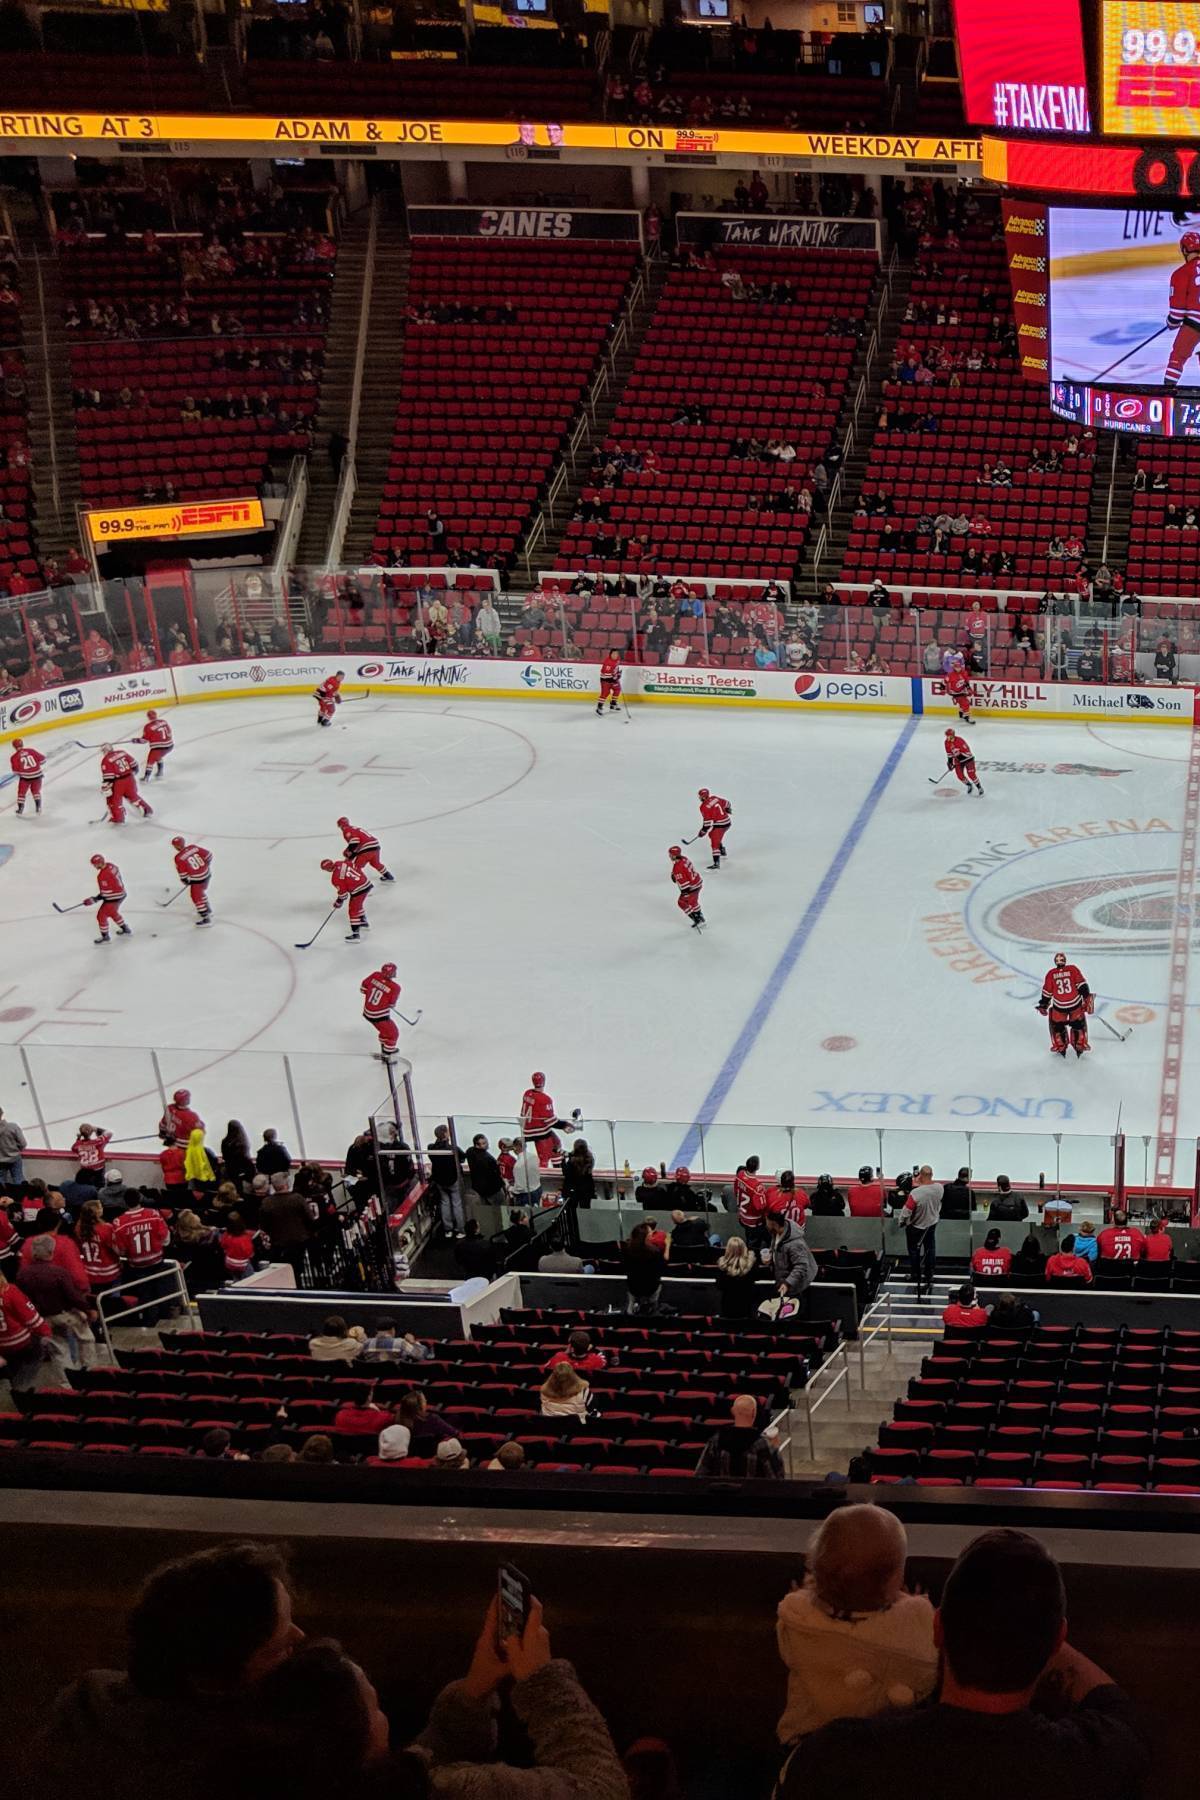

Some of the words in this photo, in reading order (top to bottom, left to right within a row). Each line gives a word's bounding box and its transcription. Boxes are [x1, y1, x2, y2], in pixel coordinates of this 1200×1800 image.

[1122, 28, 1195, 65] 99.9
[0, 116, 82, 136] RTING
[102, 118, 129, 136] AT
[139, 118, 154, 136] 3
[275, 121, 350, 139] ADAM
[366, 123, 383, 140] &
[397, 123, 442, 142] JOE
[628, 129, 663, 148] ON
[808, 135, 920, 157] WEEKDAY
[479, 210, 572, 238] CANES
[722, 221, 761, 242] TAKE
[769, 221, 842, 245] WARNING
[1124, 210, 1164, 240] LIVE
[1150, 400, 1162, 422] 0
[1104, 419, 1151, 433] HURRICANES
[181, 503, 250, 526] ESPN
[100, 518, 134, 533] 99.9
[198, 671, 248, 682] VECTOR
[385, 661, 415, 678] TAKE
[417, 661, 471, 686] WARNING
[544, 667, 573, 678] DUKE
[657, 672, 703, 685] Harris
[707, 674, 754, 687] Teeter
[545, 677, 589, 690] ENERGY
[826, 681, 884, 700] pepsi
[931, 681, 994, 698] BLY
[1002, 684, 1047, 700] HILL
[44, 699, 57, 712] ON
[952, 697, 1028, 709] VNEYARDS
[1073, 693, 1124, 708] Michael
[1157, 698, 1181, 711] Son
[19, 755, 37, 769] 20
[947, 842, 1026, 877] PNC
[1024, 817, 1173, 848] ARENA
[920, 911, 1018, 984] ARENA
[1056, 978, 1072, 994] 33
[368, 989, 384, 1006] 19
[810, 1090, 937, 1115] REX
[950, 1095, 1076, 1120] UNC
[78, 1150, 100, 1165] 28
[133, 1231, 151, 1254] 11
[1114, 1243, 1132, 1260] 23
